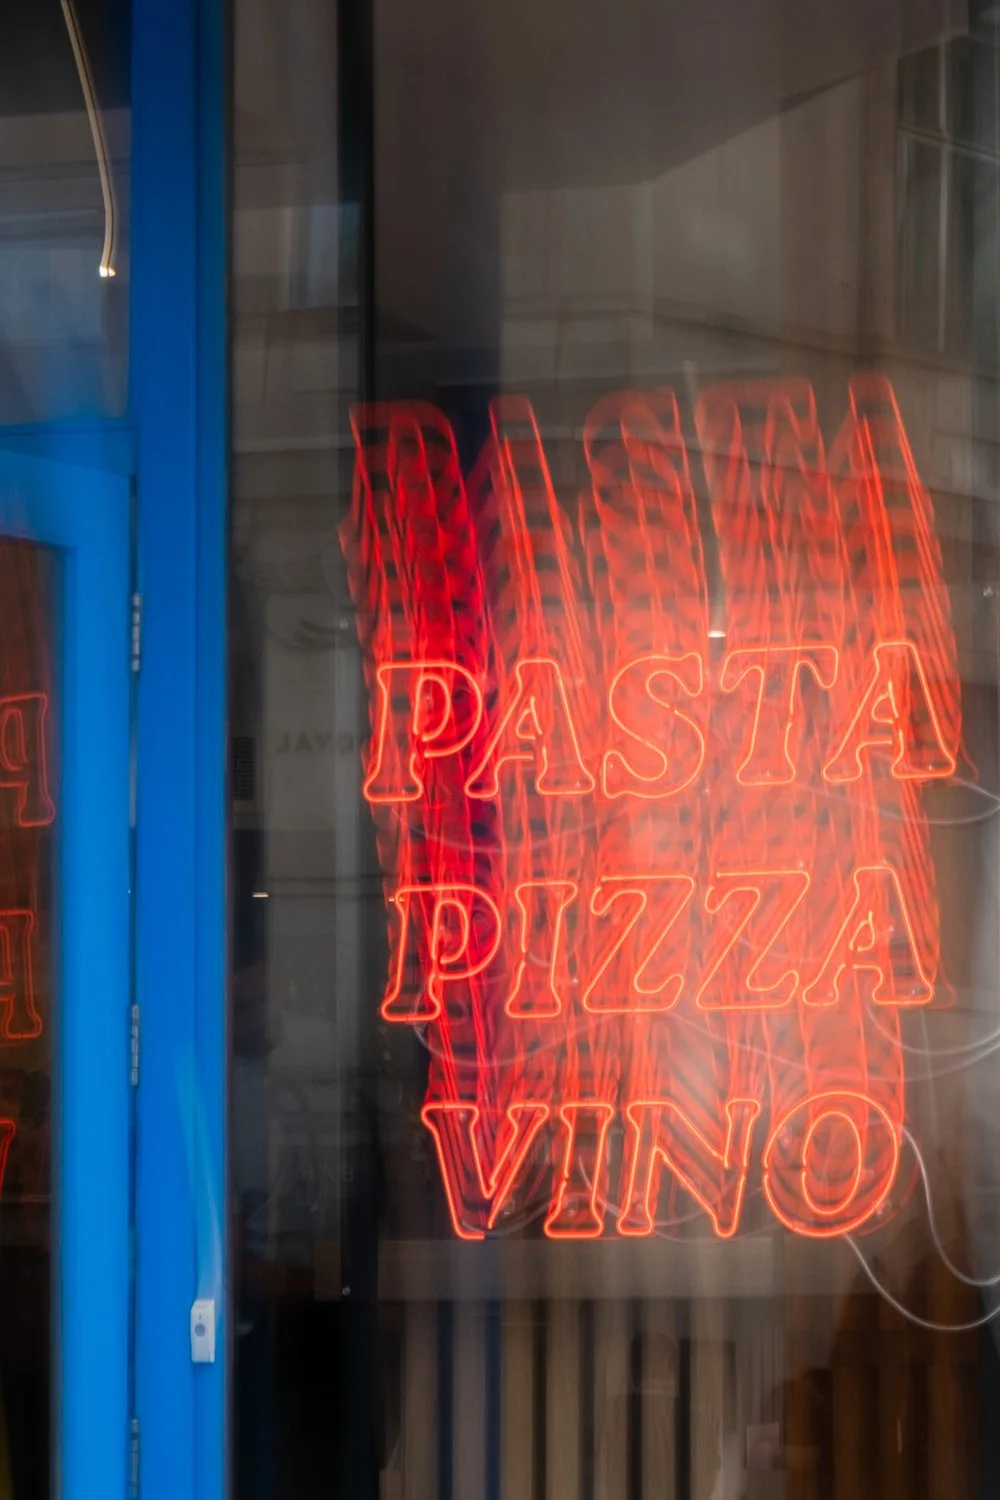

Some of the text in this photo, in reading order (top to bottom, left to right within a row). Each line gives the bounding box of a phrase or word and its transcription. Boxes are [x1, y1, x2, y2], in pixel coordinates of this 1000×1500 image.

[363, 641, 957, 802] PASTA
[381, 865, 935, 1022] PIZZA
[421, 1090, 904, 1240] VINO
